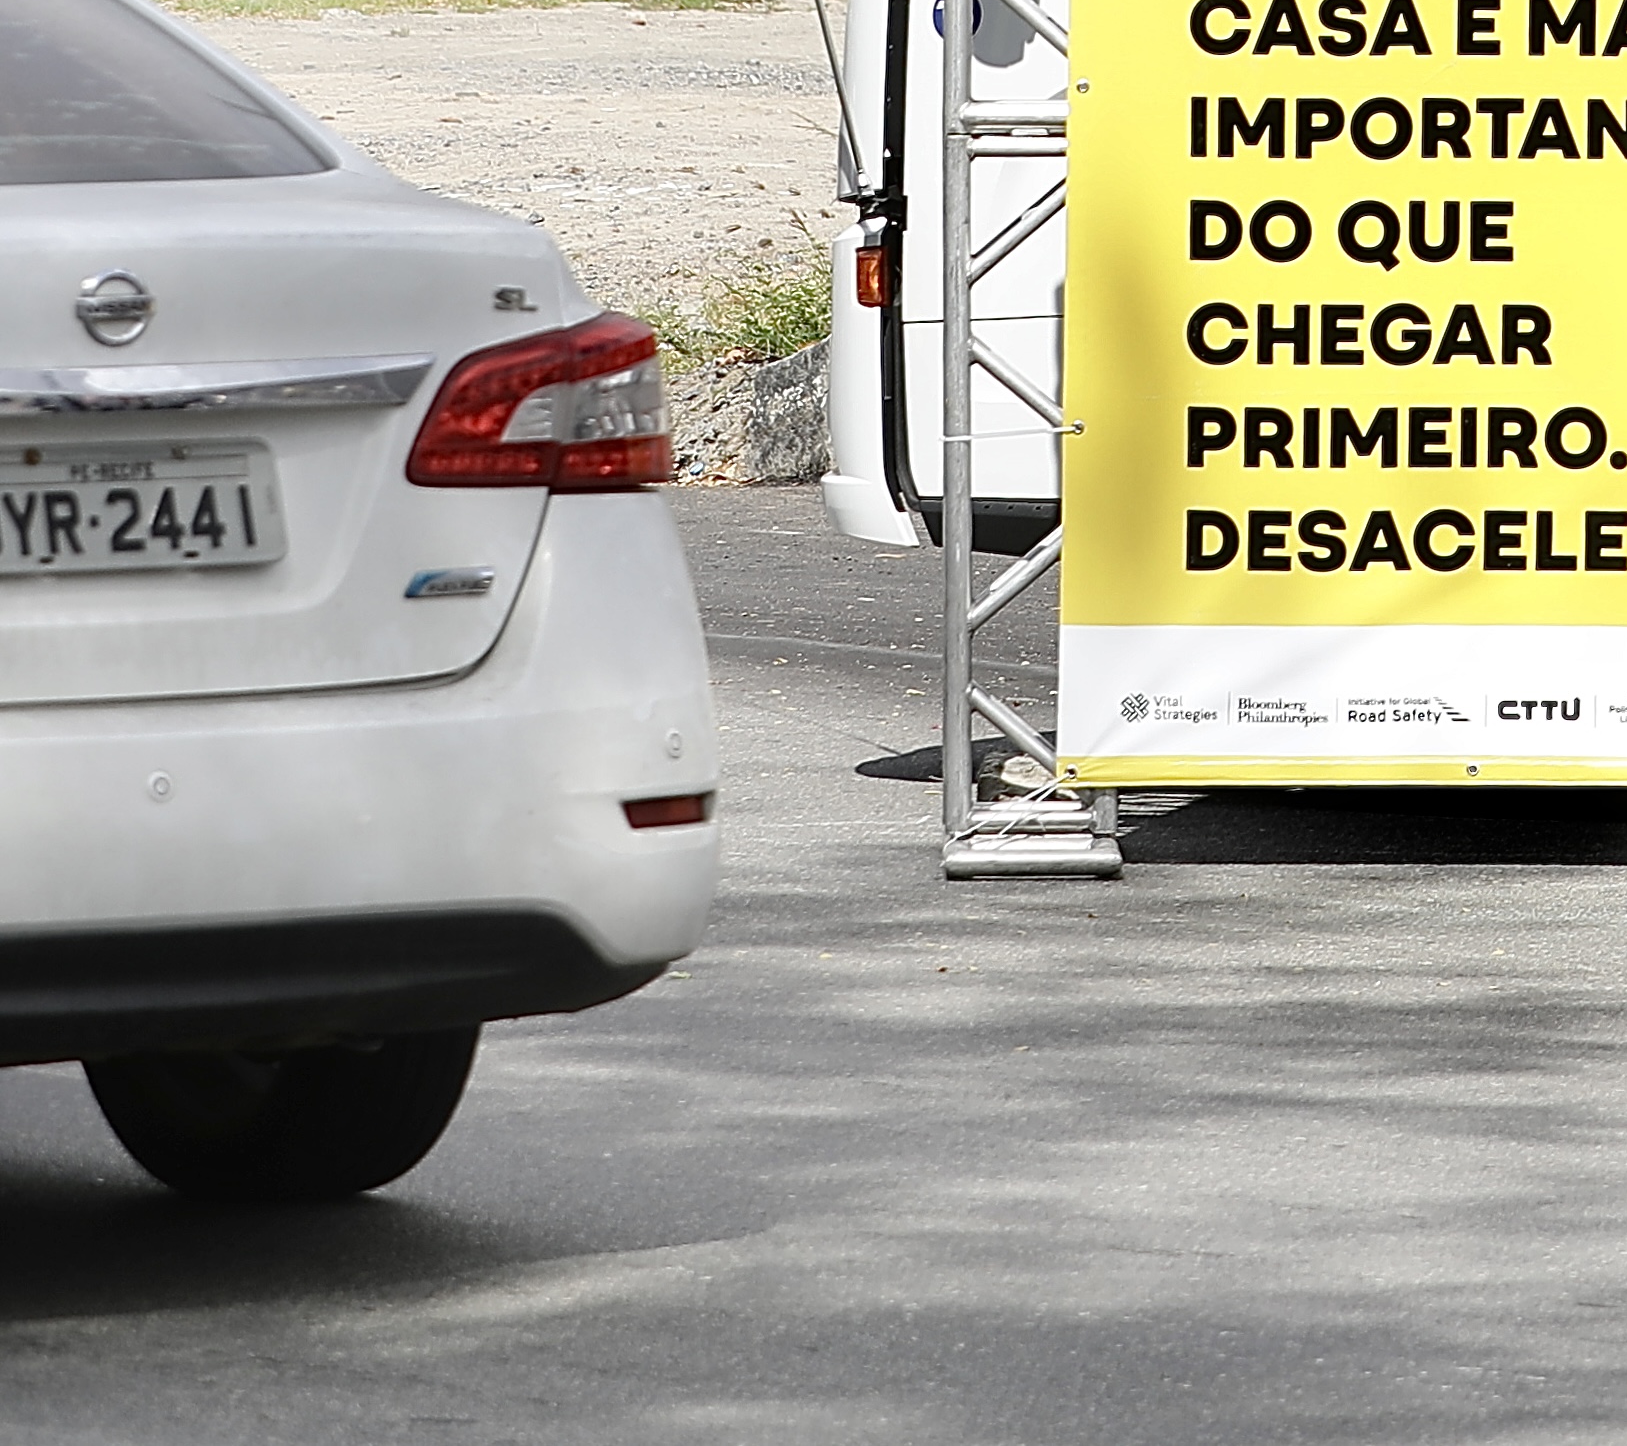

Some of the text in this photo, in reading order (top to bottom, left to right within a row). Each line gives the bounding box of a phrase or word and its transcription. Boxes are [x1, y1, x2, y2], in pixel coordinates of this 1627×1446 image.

[1189, 198, 1514, 272] DO QUE
[1187, 301, 1553, 367] CHEGAR
[1153, 695, 1183, 707] Vital
[1238, 697, 1307, 713] Bloomberg
[1497, 696, 1580, 721] CTTU
[1154, 708, 1218, 723] Strategies
[1348, 708, 1442, 727] Road Safety
